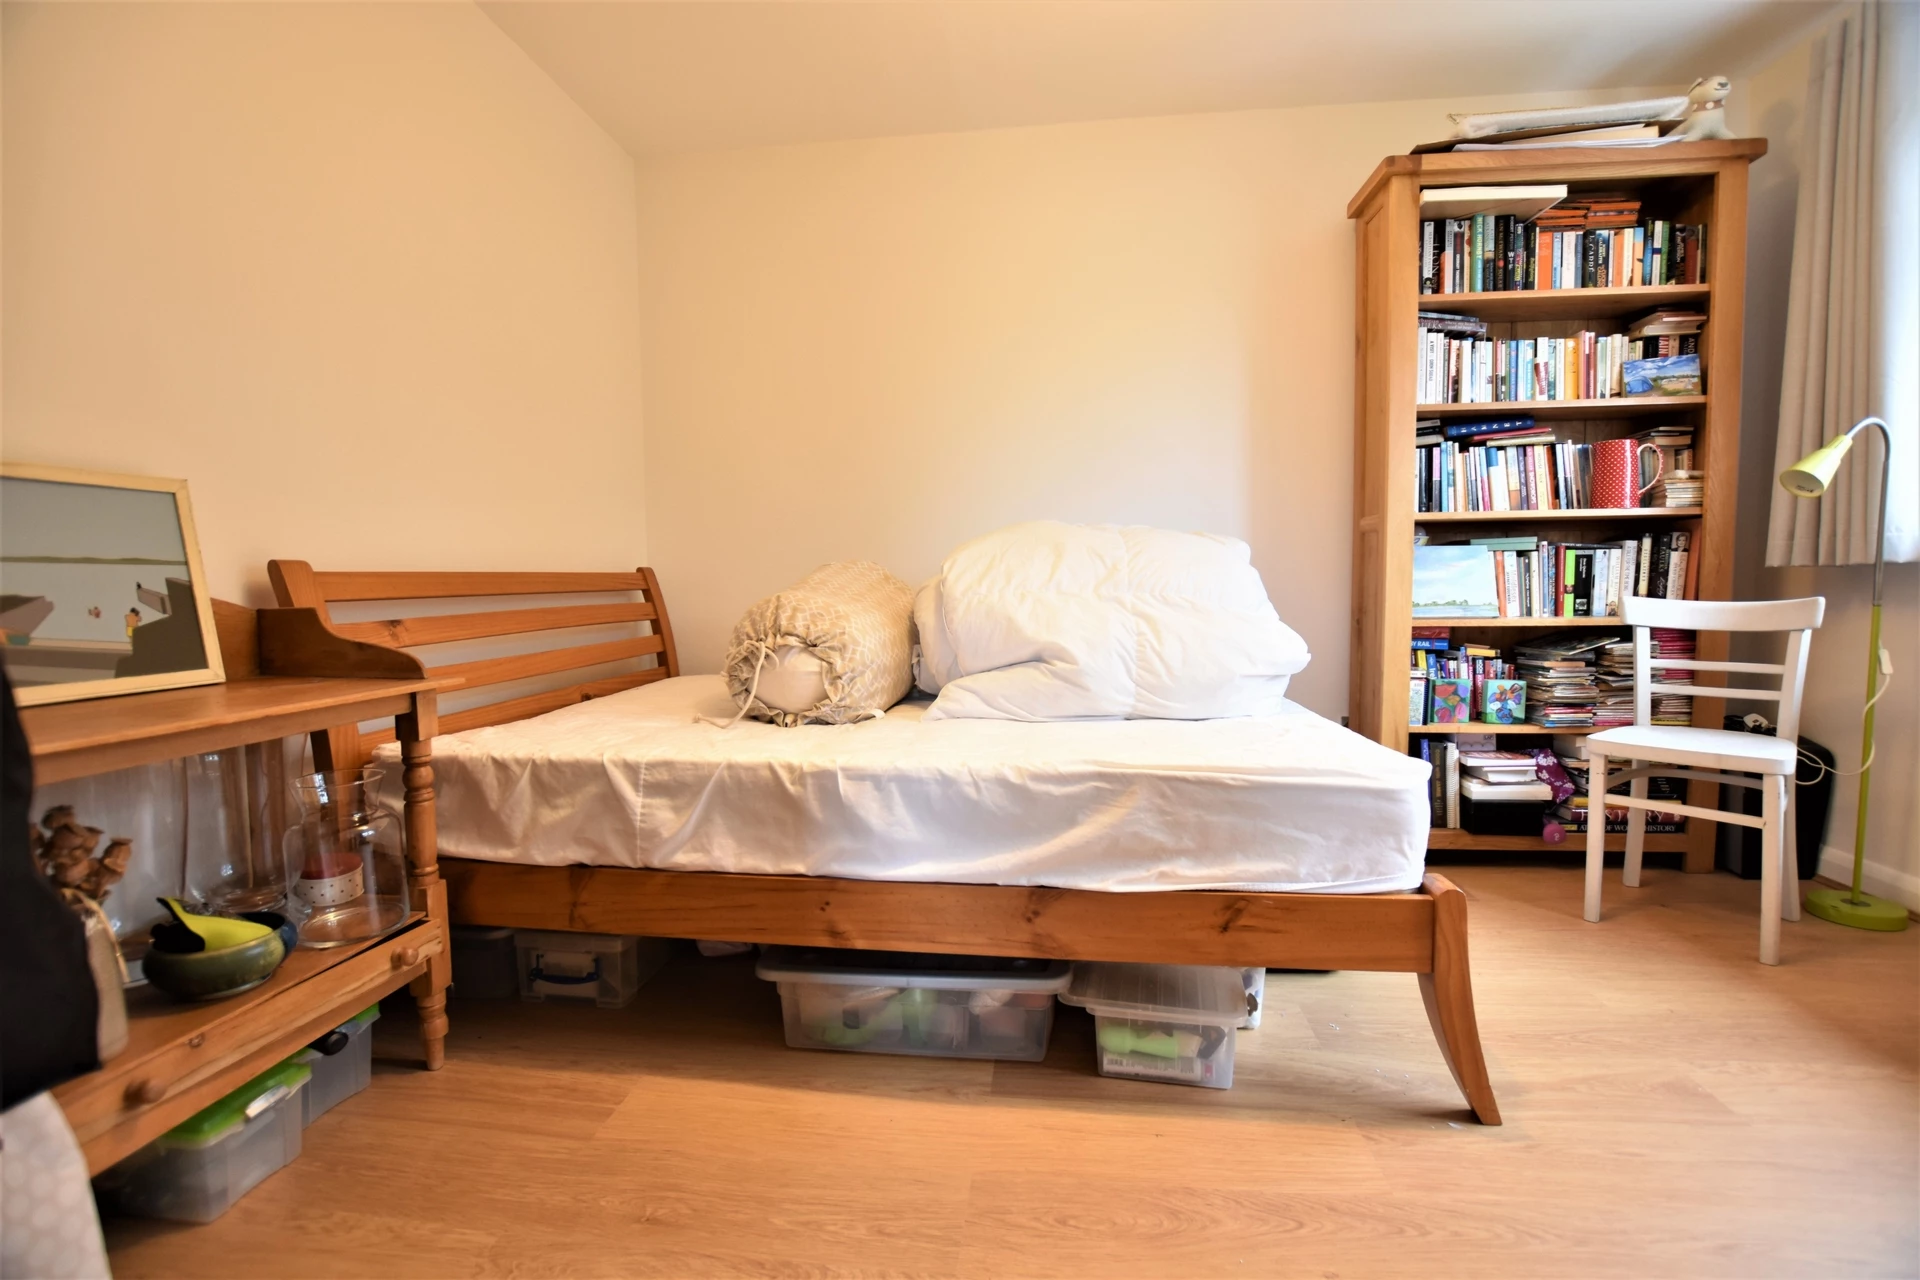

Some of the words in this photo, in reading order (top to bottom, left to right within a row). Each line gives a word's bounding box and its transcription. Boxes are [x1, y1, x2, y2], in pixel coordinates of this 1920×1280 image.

[1659, 337, 1669, 354] IAIN
[1658, 546, 1667, 573] FAULKS
[1578, 809, 1664, 823] HSTRY
